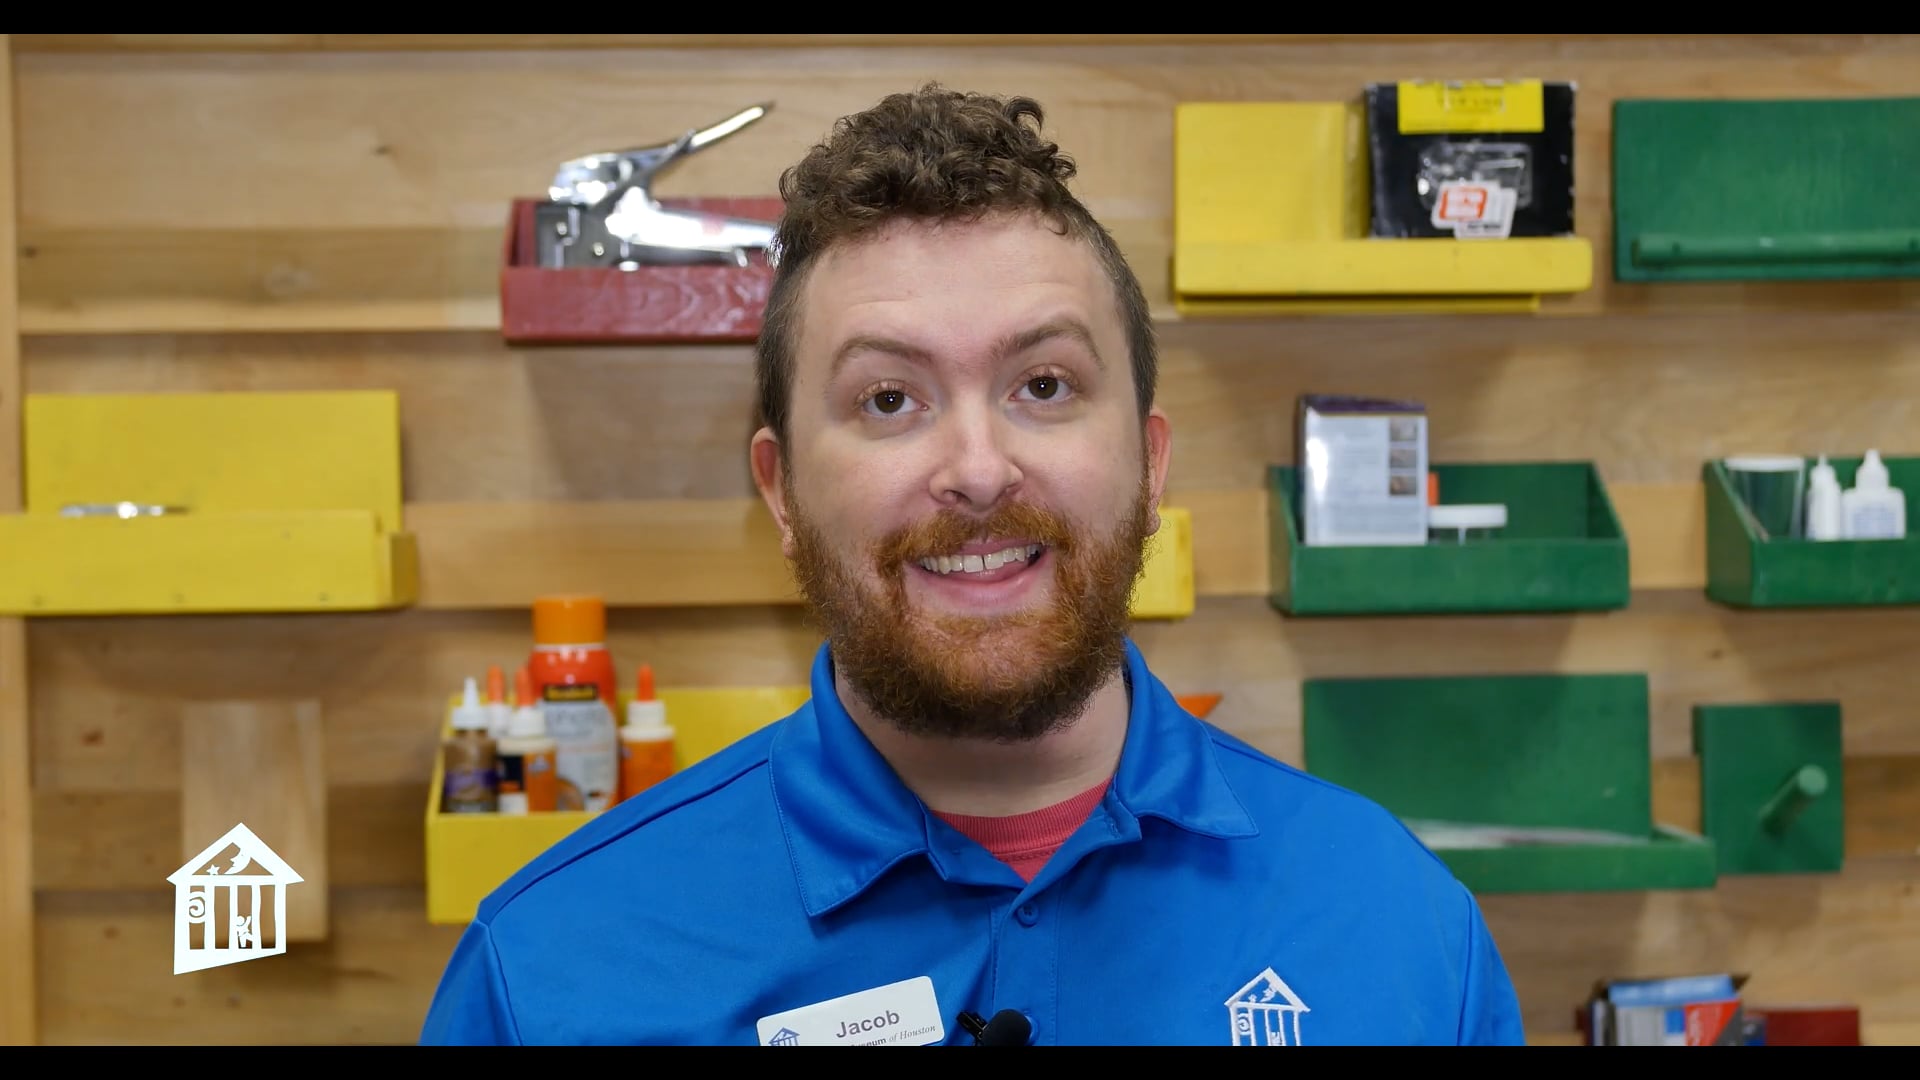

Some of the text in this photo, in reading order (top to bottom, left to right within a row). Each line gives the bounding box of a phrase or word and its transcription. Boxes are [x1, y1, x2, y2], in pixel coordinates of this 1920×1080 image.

[836, 1010, 900, 1038] Jacob
[888, 1033, 898, 1043] of
[899, 1025, 936, 1040] Houston
